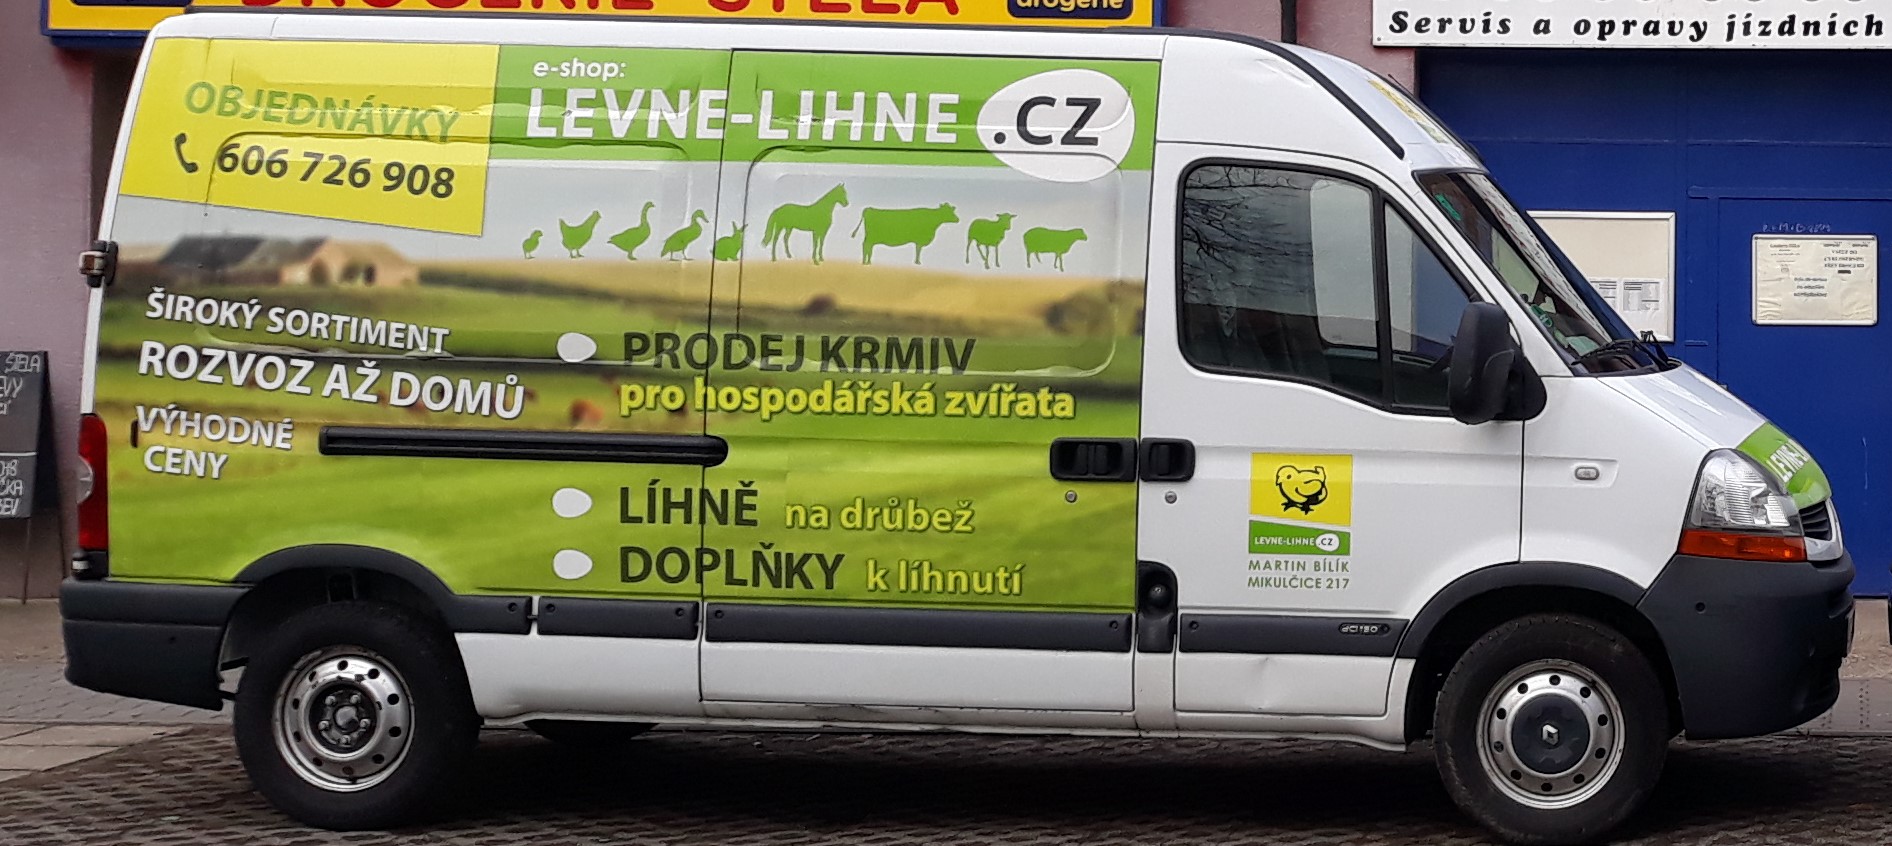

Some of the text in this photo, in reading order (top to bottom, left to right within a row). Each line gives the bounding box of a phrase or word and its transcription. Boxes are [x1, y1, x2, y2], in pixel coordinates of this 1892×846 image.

[1388, 10, 1511, 34] Servis
[1532, 18, 1552, 36] a
[1573, 18, 1708, 42] opravy
[1725, 12, 1884, 42] jízdních
[533, 57, 627, 81] e-shop:
[185, 80, 460, 143] OBJEDNÁVKY
[217, 142, 455, 199] 606 726 908
[145, 287, 451, 354] ŠIROKÝ SORTIMENT
[623, 331, 977, 376] PRODEJ KRMIV
[138, 340, 525, 420] ROZVOZ AŽ DOMŮ
[619, 375, 1076, 422] pro hospodářská zvířata
[135, 403, 294, 451] VÝHODNÉ
[143, 445, 229, 480] CENY
[619, 479, 975, 534] LÍHNĚ na drůbež
[619, 542, 1027, 597] DOPLŇKY k líhnutí
[1247, 574, 1350, 589] MIKULČICE 217
[1248, 557, 1350, 573] MARTIN BÍLÍK
